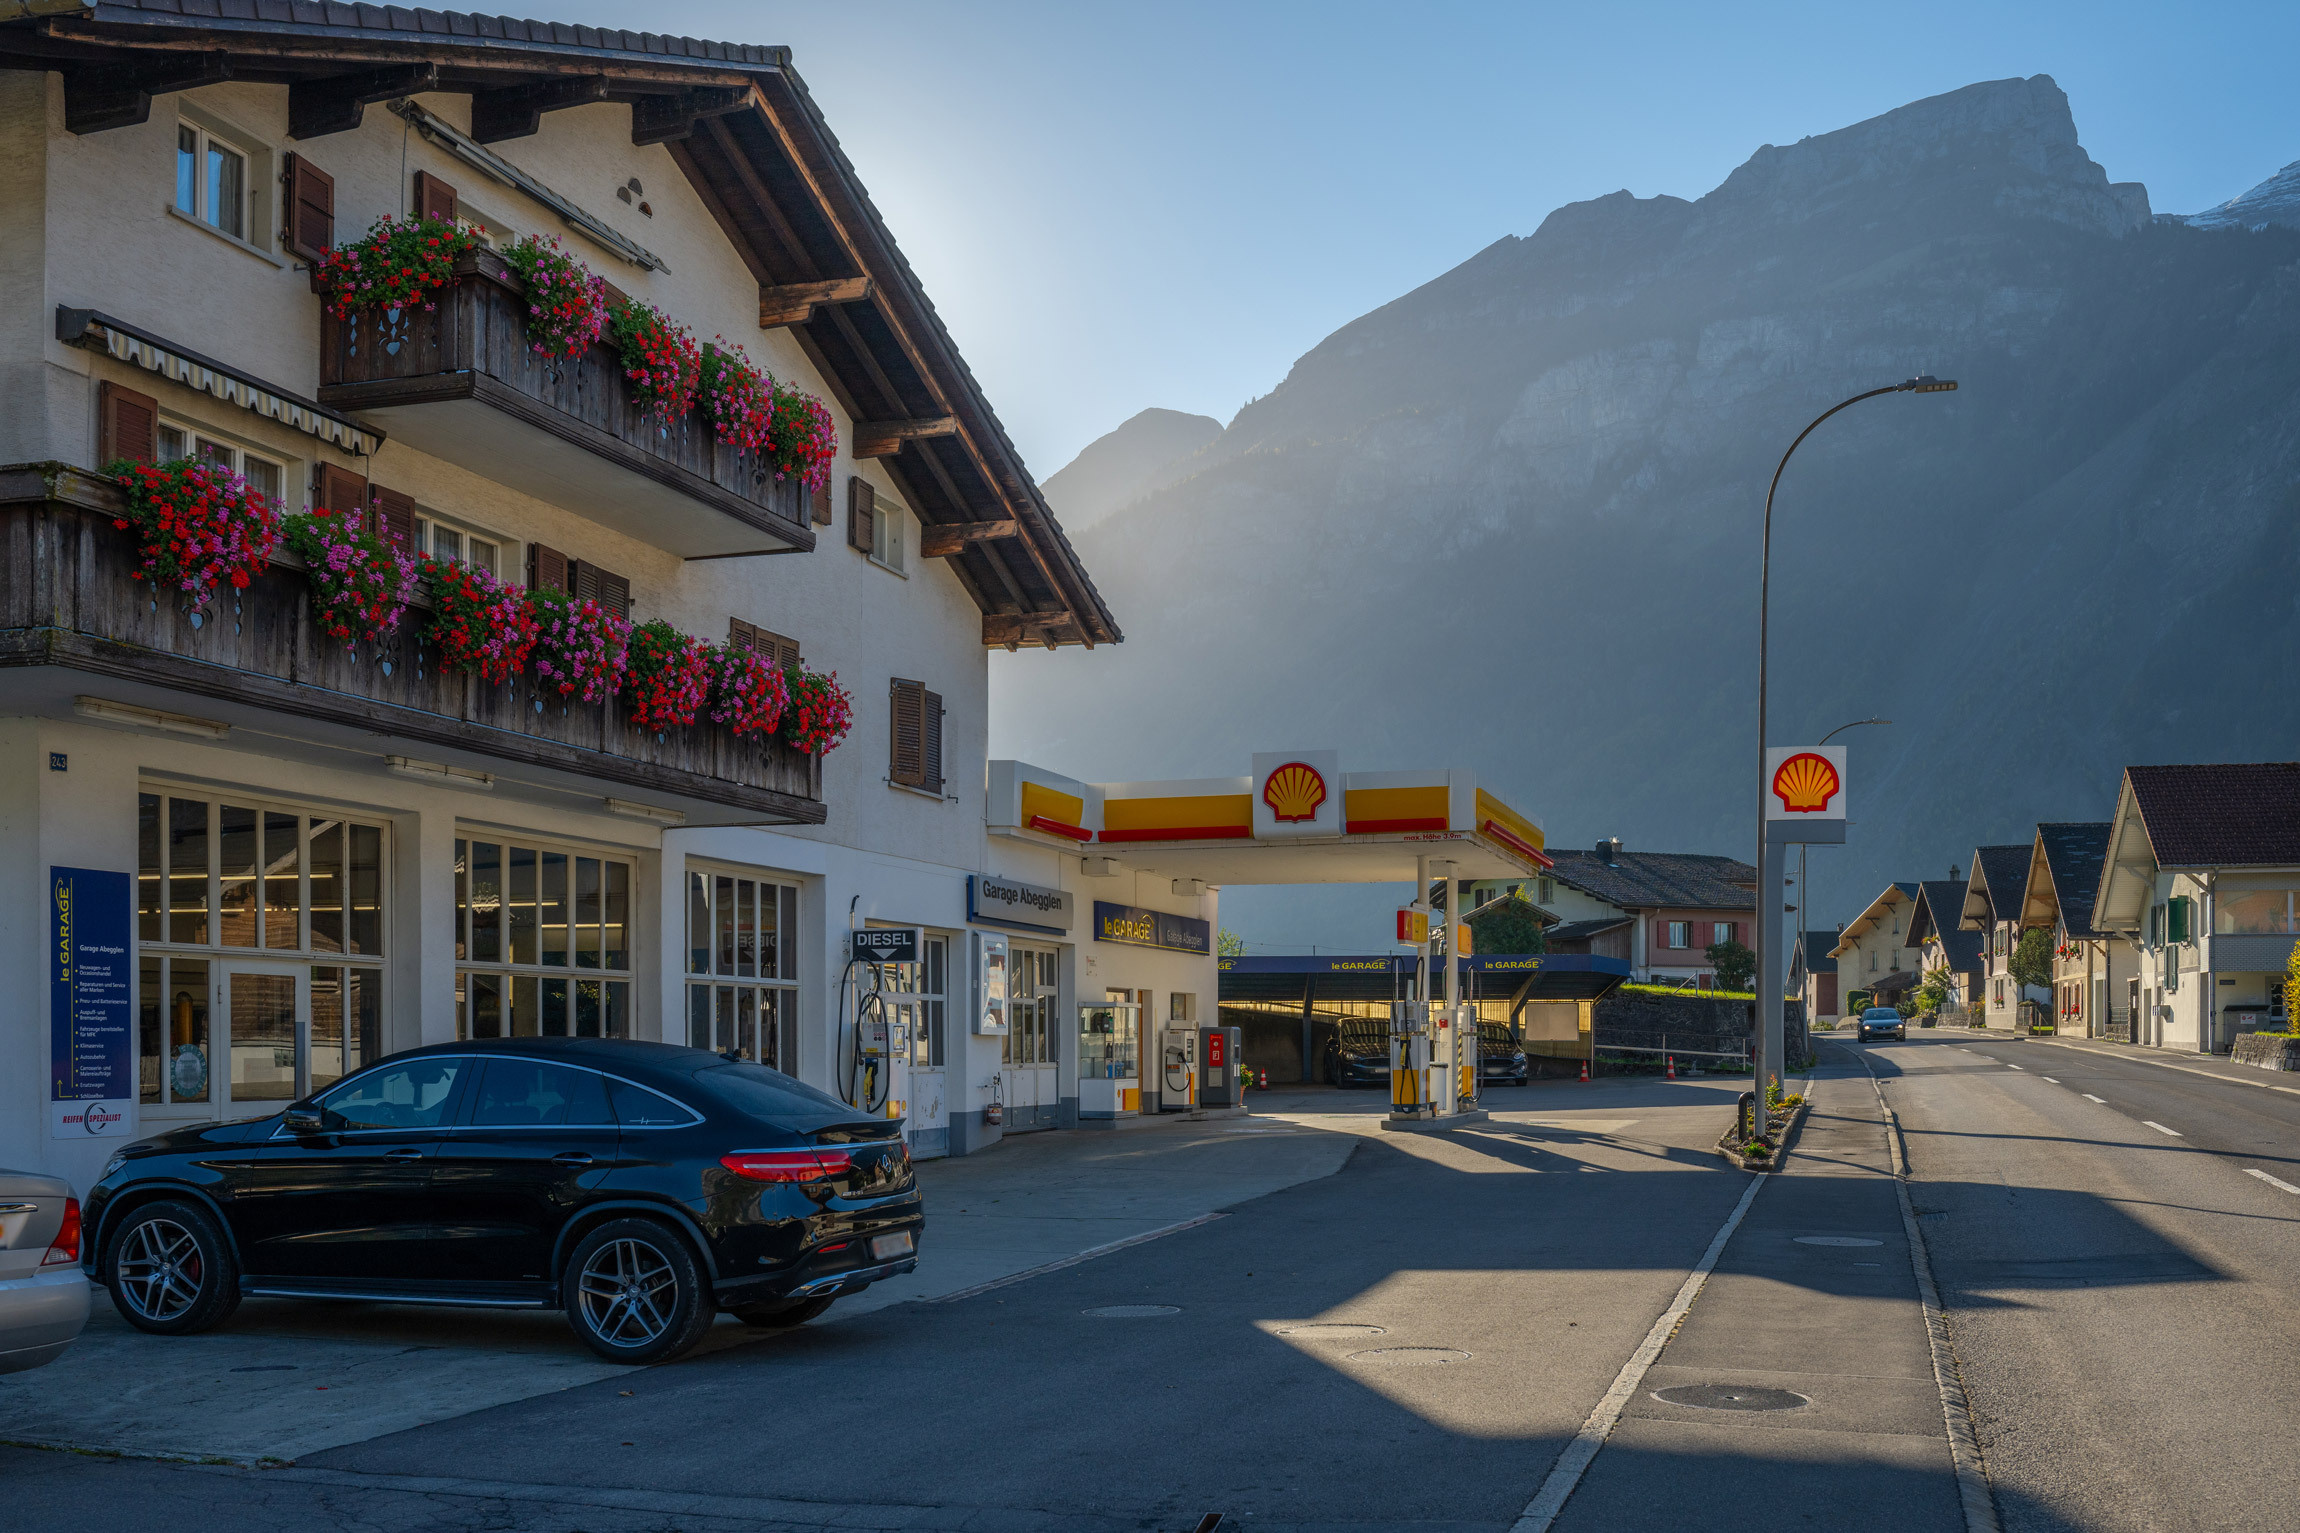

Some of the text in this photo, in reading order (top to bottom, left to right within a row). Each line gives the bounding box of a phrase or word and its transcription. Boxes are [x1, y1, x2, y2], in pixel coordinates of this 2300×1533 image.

[51, 756, 66, 768] 243
[983, 880, 1062, 912] Garage Abegglen
[60, 887, 70, 981] le GARAGE
[1104, 916, 1151, 940] le GARAGE
[857, 933, 912, 946] DIESEL
[1166, 929, 1203, 949] Garage Abegglen
[80, 944, 125, 955] Garage Abegglen
[1331, 961, 1386, 970] le GARAGE
[1485, 961, 1540, 969] le GARAGE
[62, 1113, 122, 1124] REIFEN SPEZIALIST
